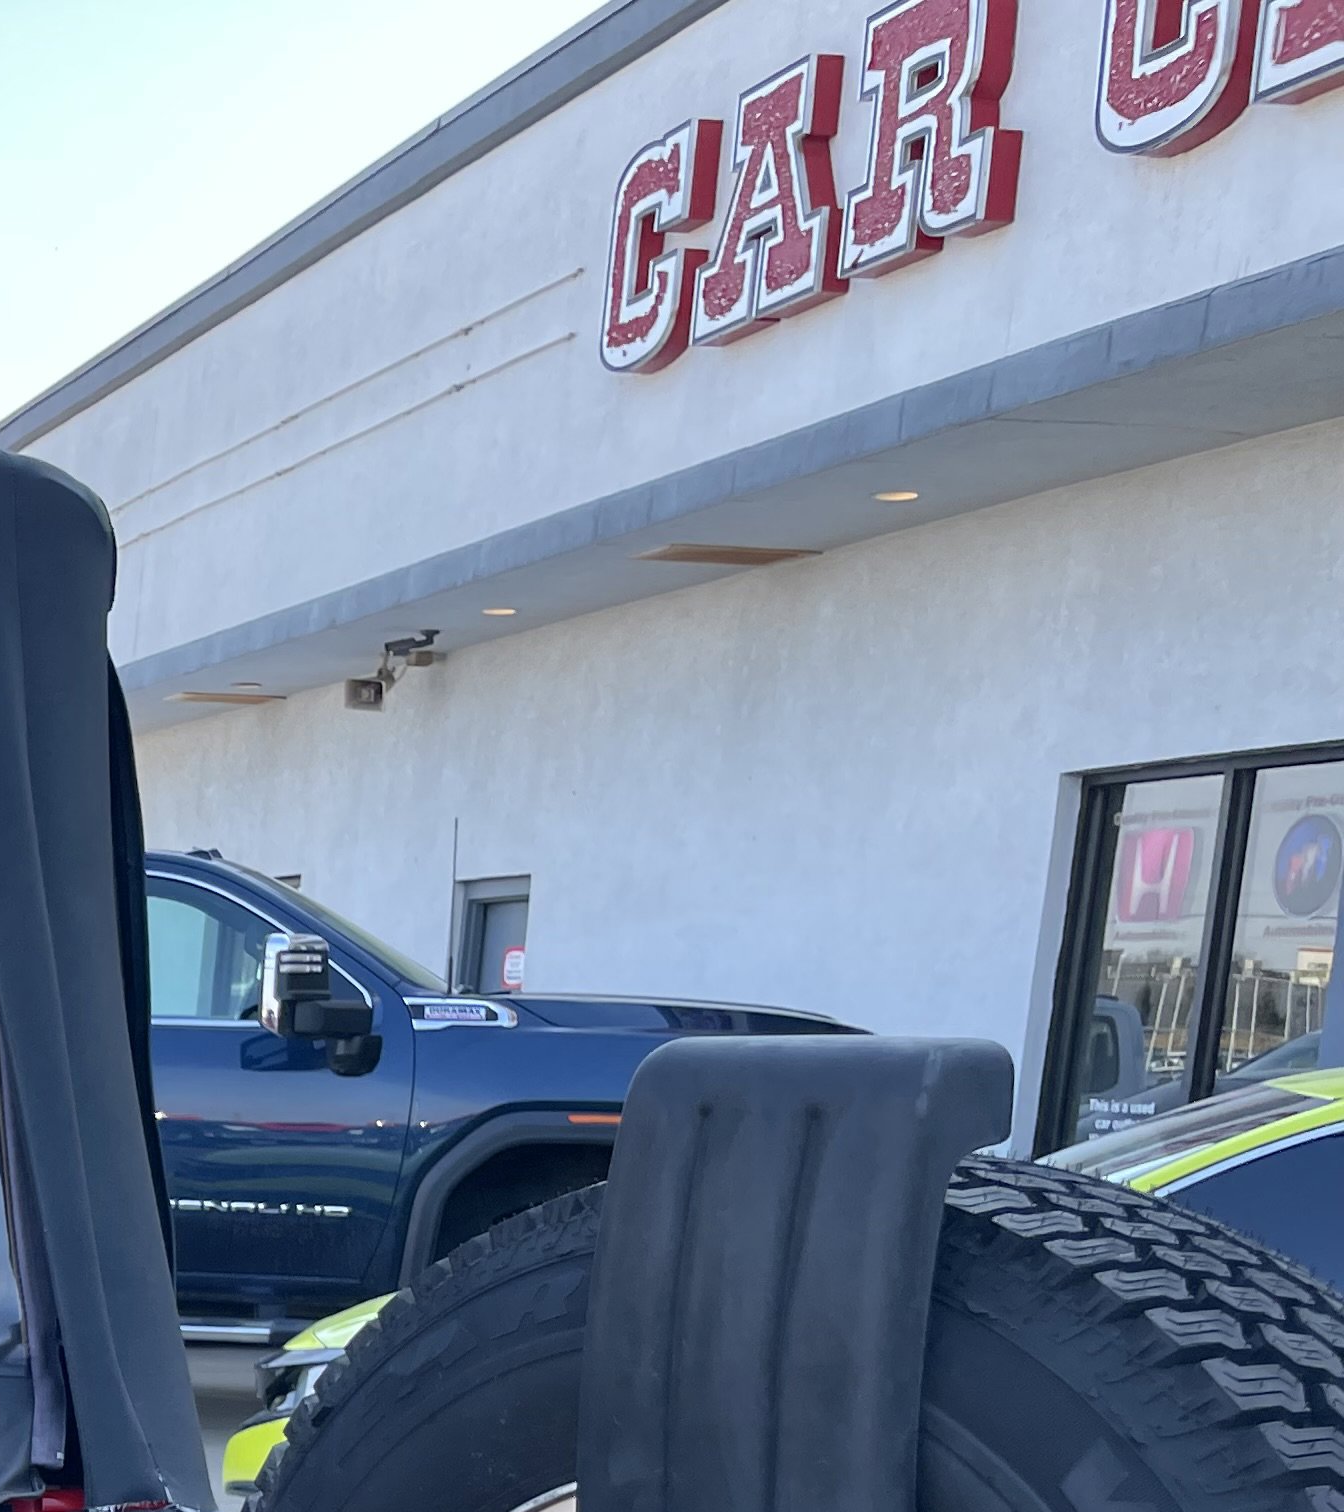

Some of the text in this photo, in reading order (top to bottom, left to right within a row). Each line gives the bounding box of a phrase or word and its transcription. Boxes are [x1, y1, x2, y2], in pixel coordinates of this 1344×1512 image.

[599, 0, 1024, 374] CAR
[1089, 1098, 1109, 1112] This
[1110, 1099, 1120, 1113] is
[1129, 1102, 1156, 1115] used
[1094, 1119, 1111, 1130] car
[169, 1199, 352, 1218] ENALI HD
